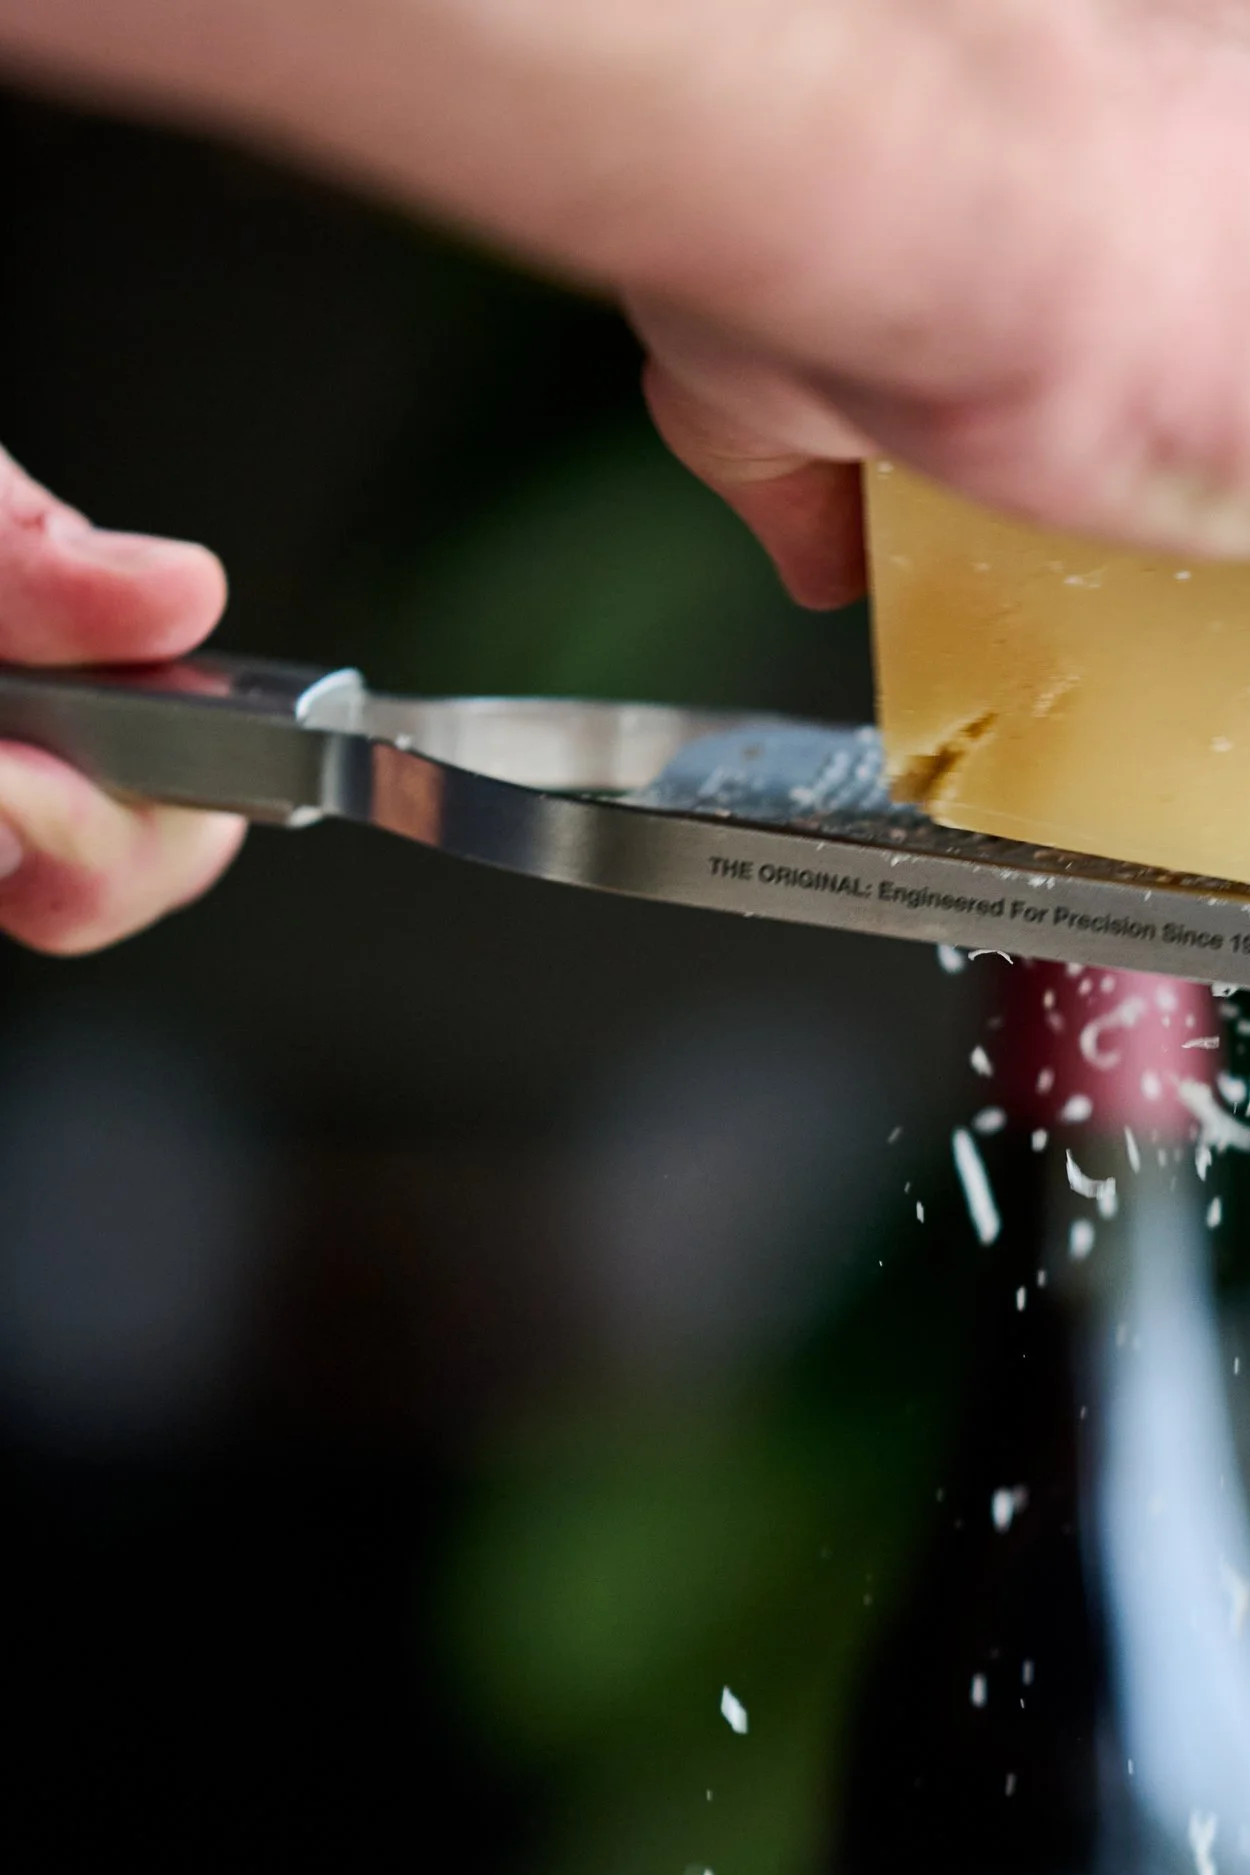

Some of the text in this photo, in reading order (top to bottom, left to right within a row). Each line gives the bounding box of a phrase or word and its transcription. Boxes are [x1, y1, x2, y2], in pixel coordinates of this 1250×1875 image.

[708, 856, 754, 881] THE
[757, 863, 873, 900] ORIGINAL:
[877, 879, 1006, 917] Engineered
[1009, 900, 1049, 925] For
[1053, 906, 1157, 941] Precision
[1161, 922, 1224, 950] Since
